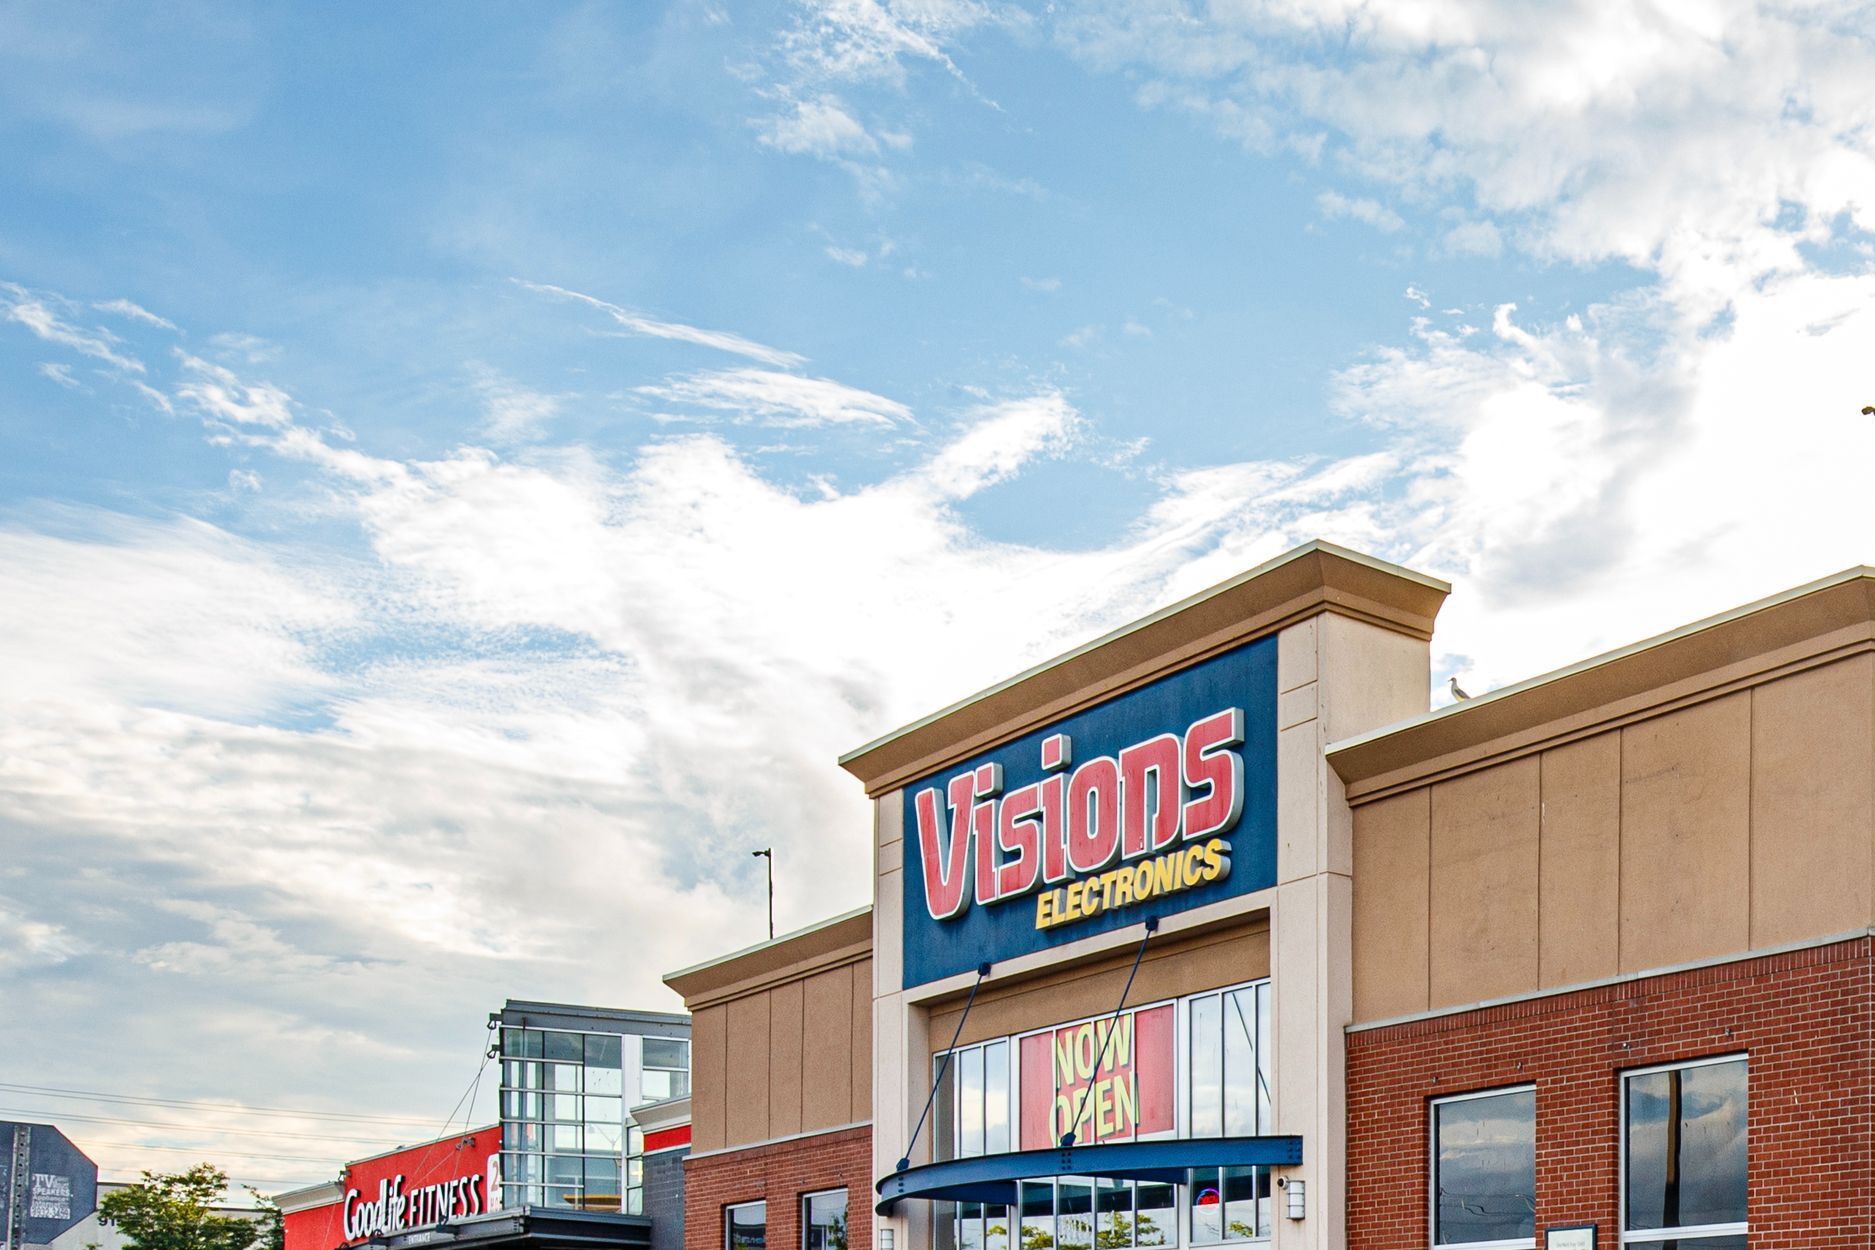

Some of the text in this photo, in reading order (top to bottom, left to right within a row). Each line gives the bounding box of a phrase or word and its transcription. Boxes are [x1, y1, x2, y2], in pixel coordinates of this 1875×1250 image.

[914, 706, 1245, 921] Visions
[1034, 838, 1232, 931] ELECTRONICS
[1051, 1012, 1132, 1089] NOW
[1048, 1071, 1140, 1148] OPEN
[410, 1173, 480, 1228] FITNESS
